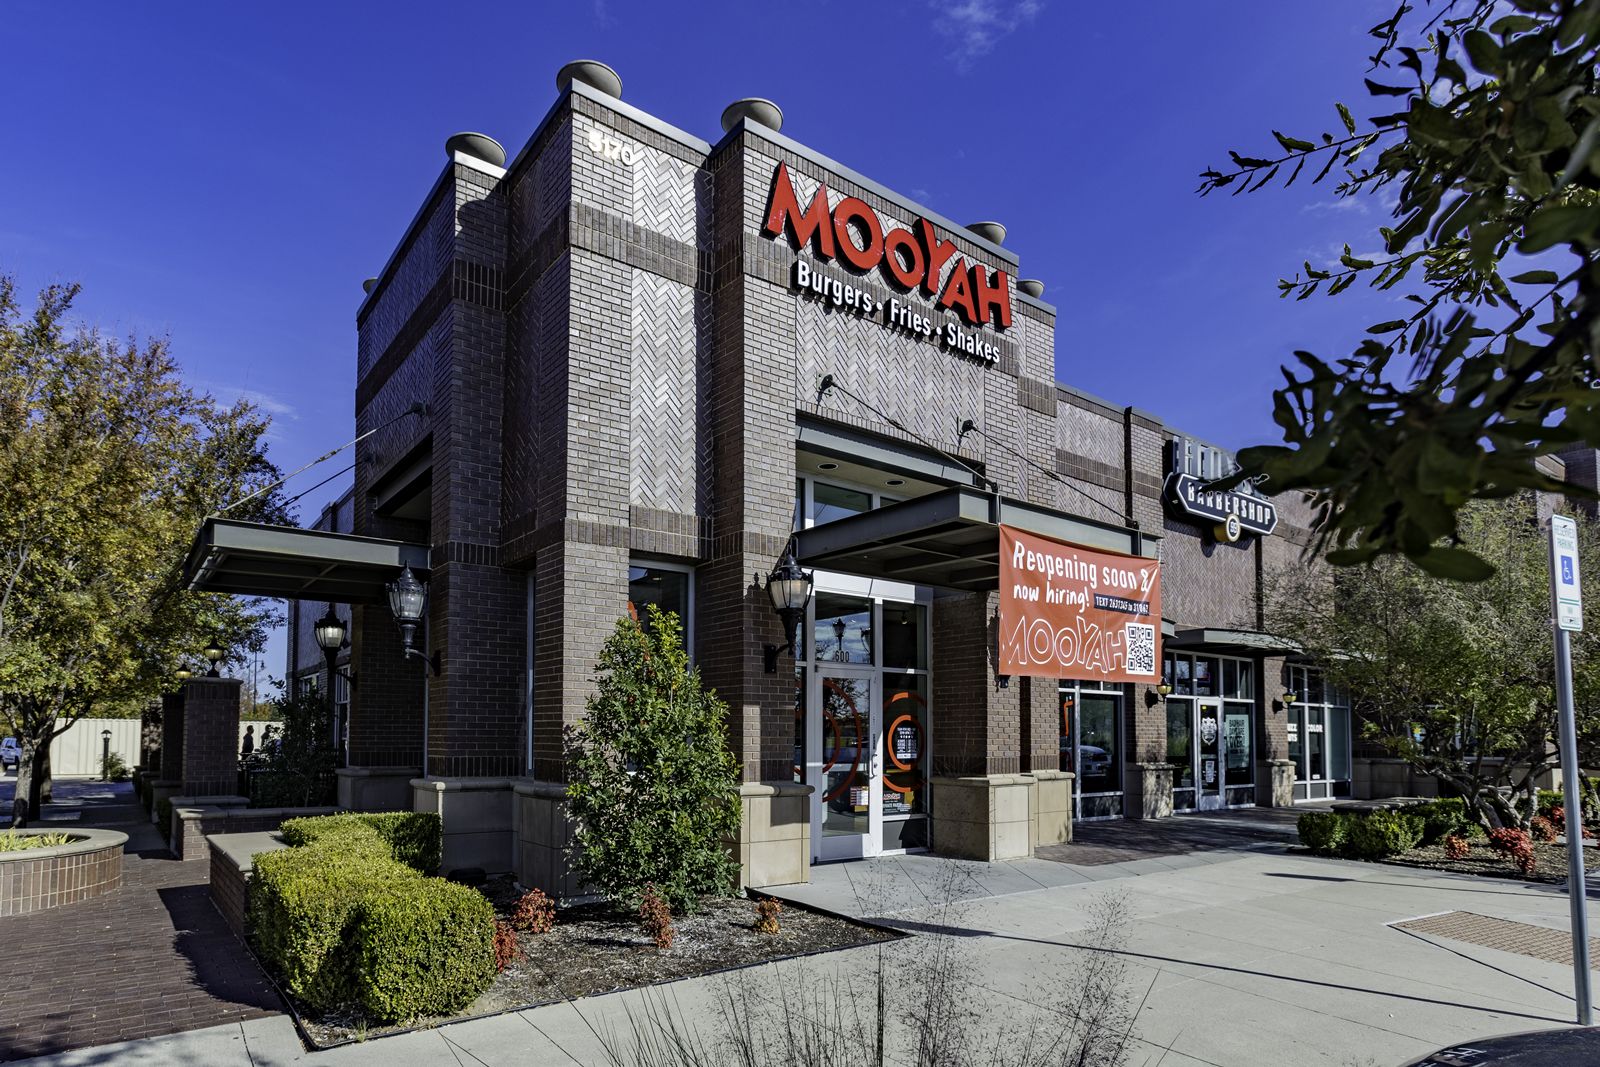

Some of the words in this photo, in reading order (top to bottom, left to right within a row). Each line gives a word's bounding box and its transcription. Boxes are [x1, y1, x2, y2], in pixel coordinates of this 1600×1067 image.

[797, 259, 873, 313] Burgers
[890, 298, 931, 336] Fries
[946, 323, 1001, 364] Shakes
[1013, 540, 1098, 590] Reopening
[1102, 566, 1137, 590] soon
[1013, 584, 1040, 602] now
[1046, 580, 1090, 614] hiring!
[835, 651, 850, 663] 600
